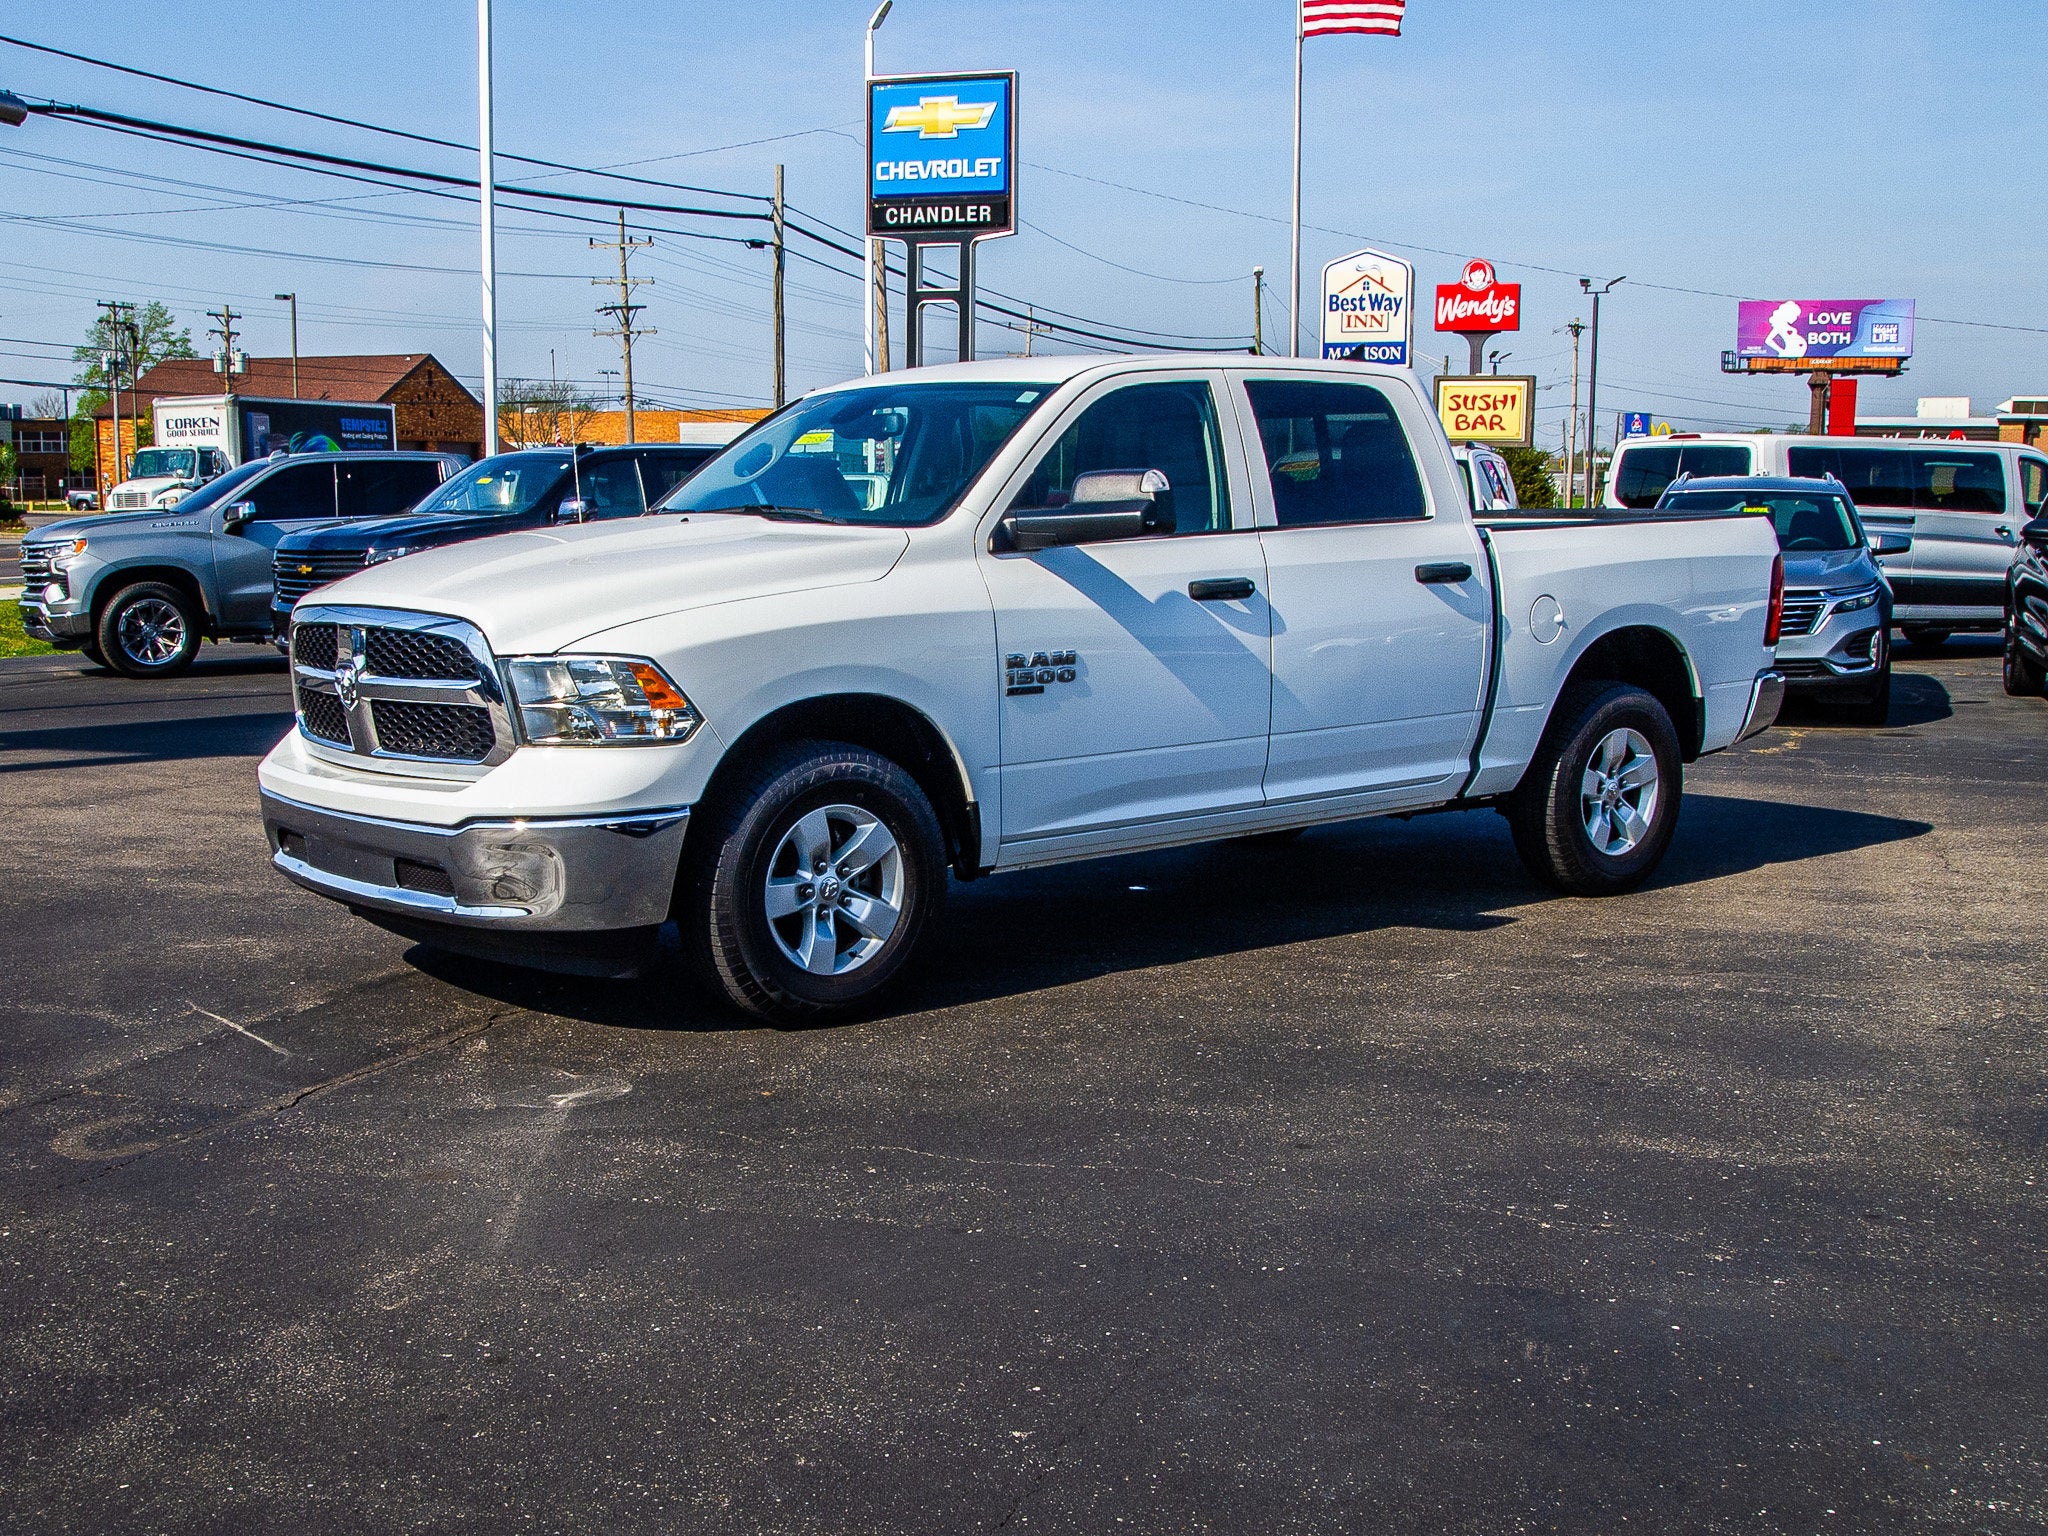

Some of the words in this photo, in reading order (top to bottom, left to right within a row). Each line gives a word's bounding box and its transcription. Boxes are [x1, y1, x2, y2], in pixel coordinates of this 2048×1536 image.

[875, 158, 1001, 181] CHEVROLET
[885, 205, 992, 225] CHANDLER
[1329, 293, 1366, 312] Best
[1368, 293, 1403, 317] Way
[1437, 290, 1516, 324] Wendy's
[1346, 314, 1384, 328] INN
[1808, 312, 1852, 325] LOVE
[1826, 323, 1851, 331] them
[1808, 332, 1851, 345] BOTH
[1872, 333, 1897, 342] LIFE
[1328, 346, 1402, 360] MAISON
[1448, 394, 1517, 411] SUSHI
[166, 417, 220, 429] CORKEN
[1455, 414, 1506, 431] BAR
[166, 429, 187, 438] GOOD
[190, 428, 220, 437] SERVICE
[1005, 649, 1076, 669] RAM
[1005, 666, 1076, 686] 1500
